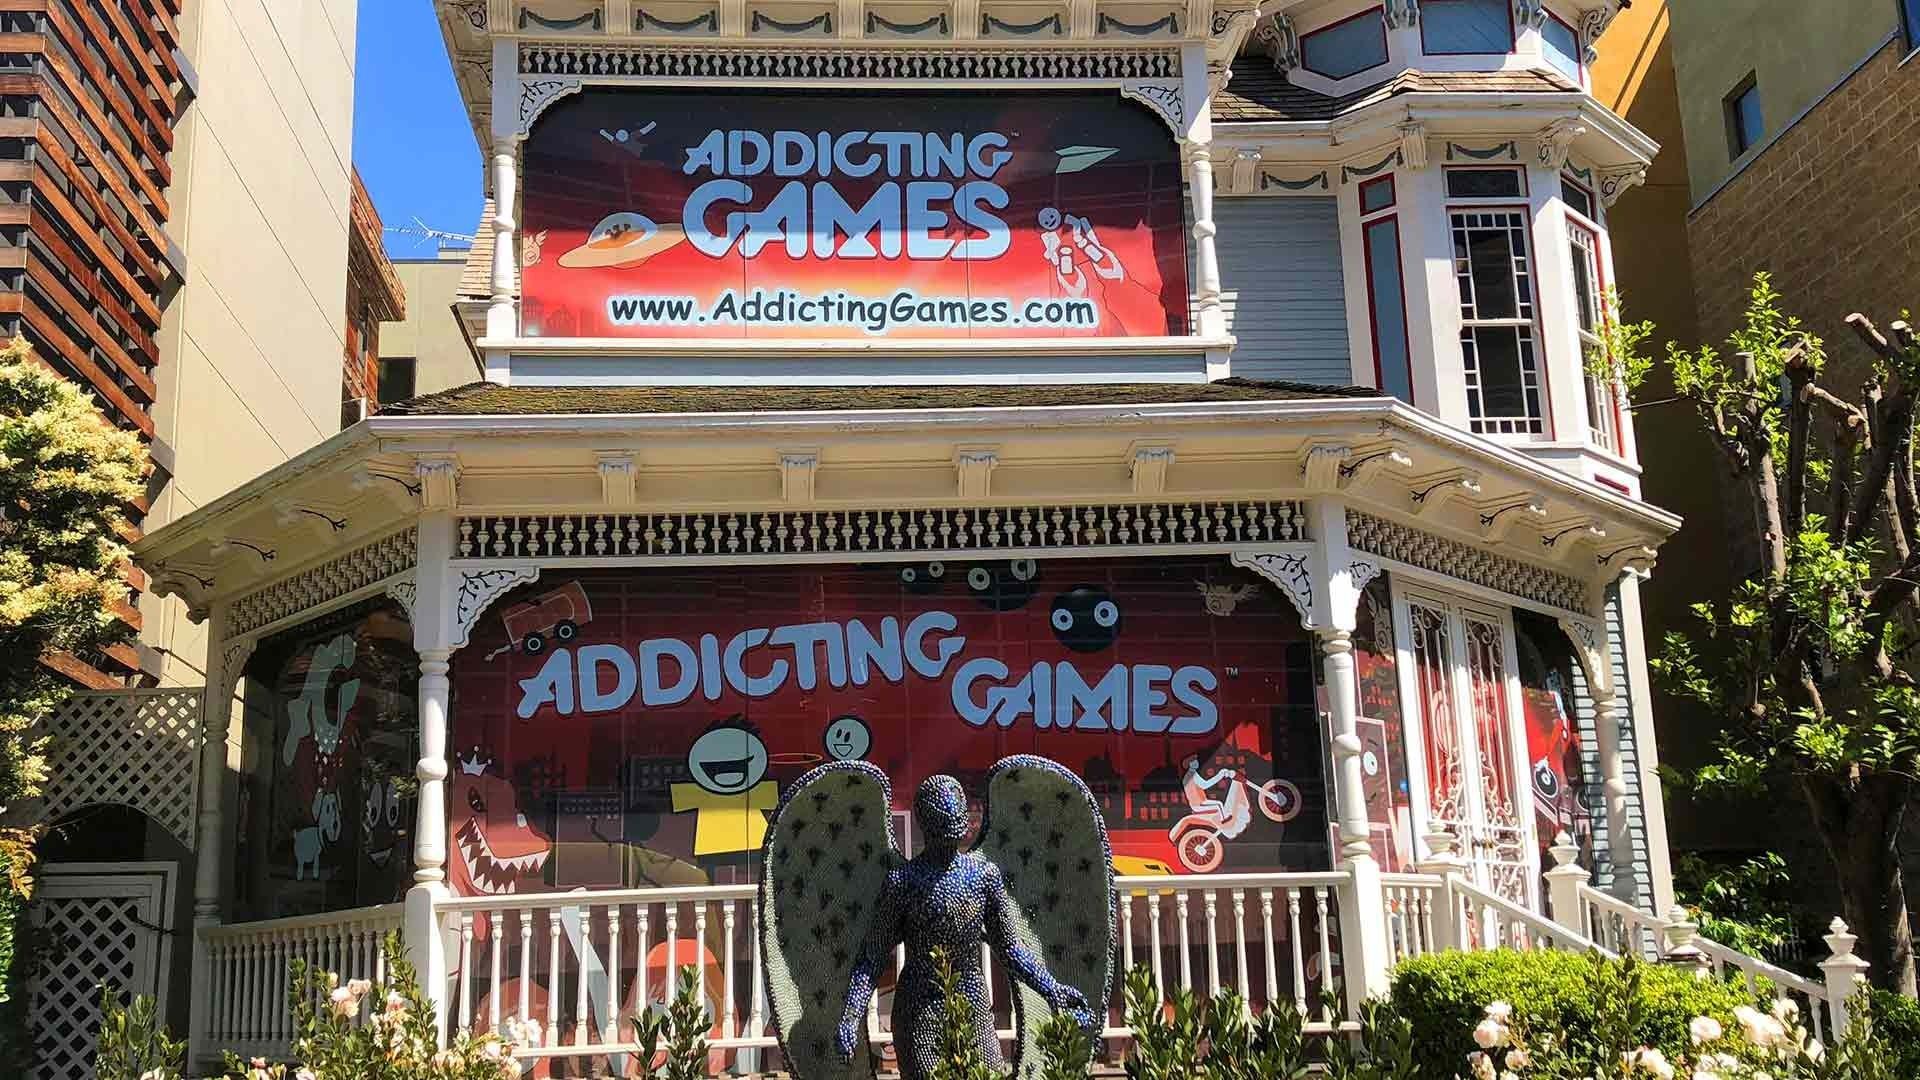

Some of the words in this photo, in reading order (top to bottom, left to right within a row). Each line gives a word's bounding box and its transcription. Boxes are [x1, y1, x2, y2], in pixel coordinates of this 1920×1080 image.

[684, 130, 1013, 177] ADDICTING
[682, 181, 1012, 260] GAMES
[611, 293, 1095, 331] www.AddictingGames.com
[517, 612, 967, 718] ADDICTING
[952, 658, 1219, 734] GAMES
